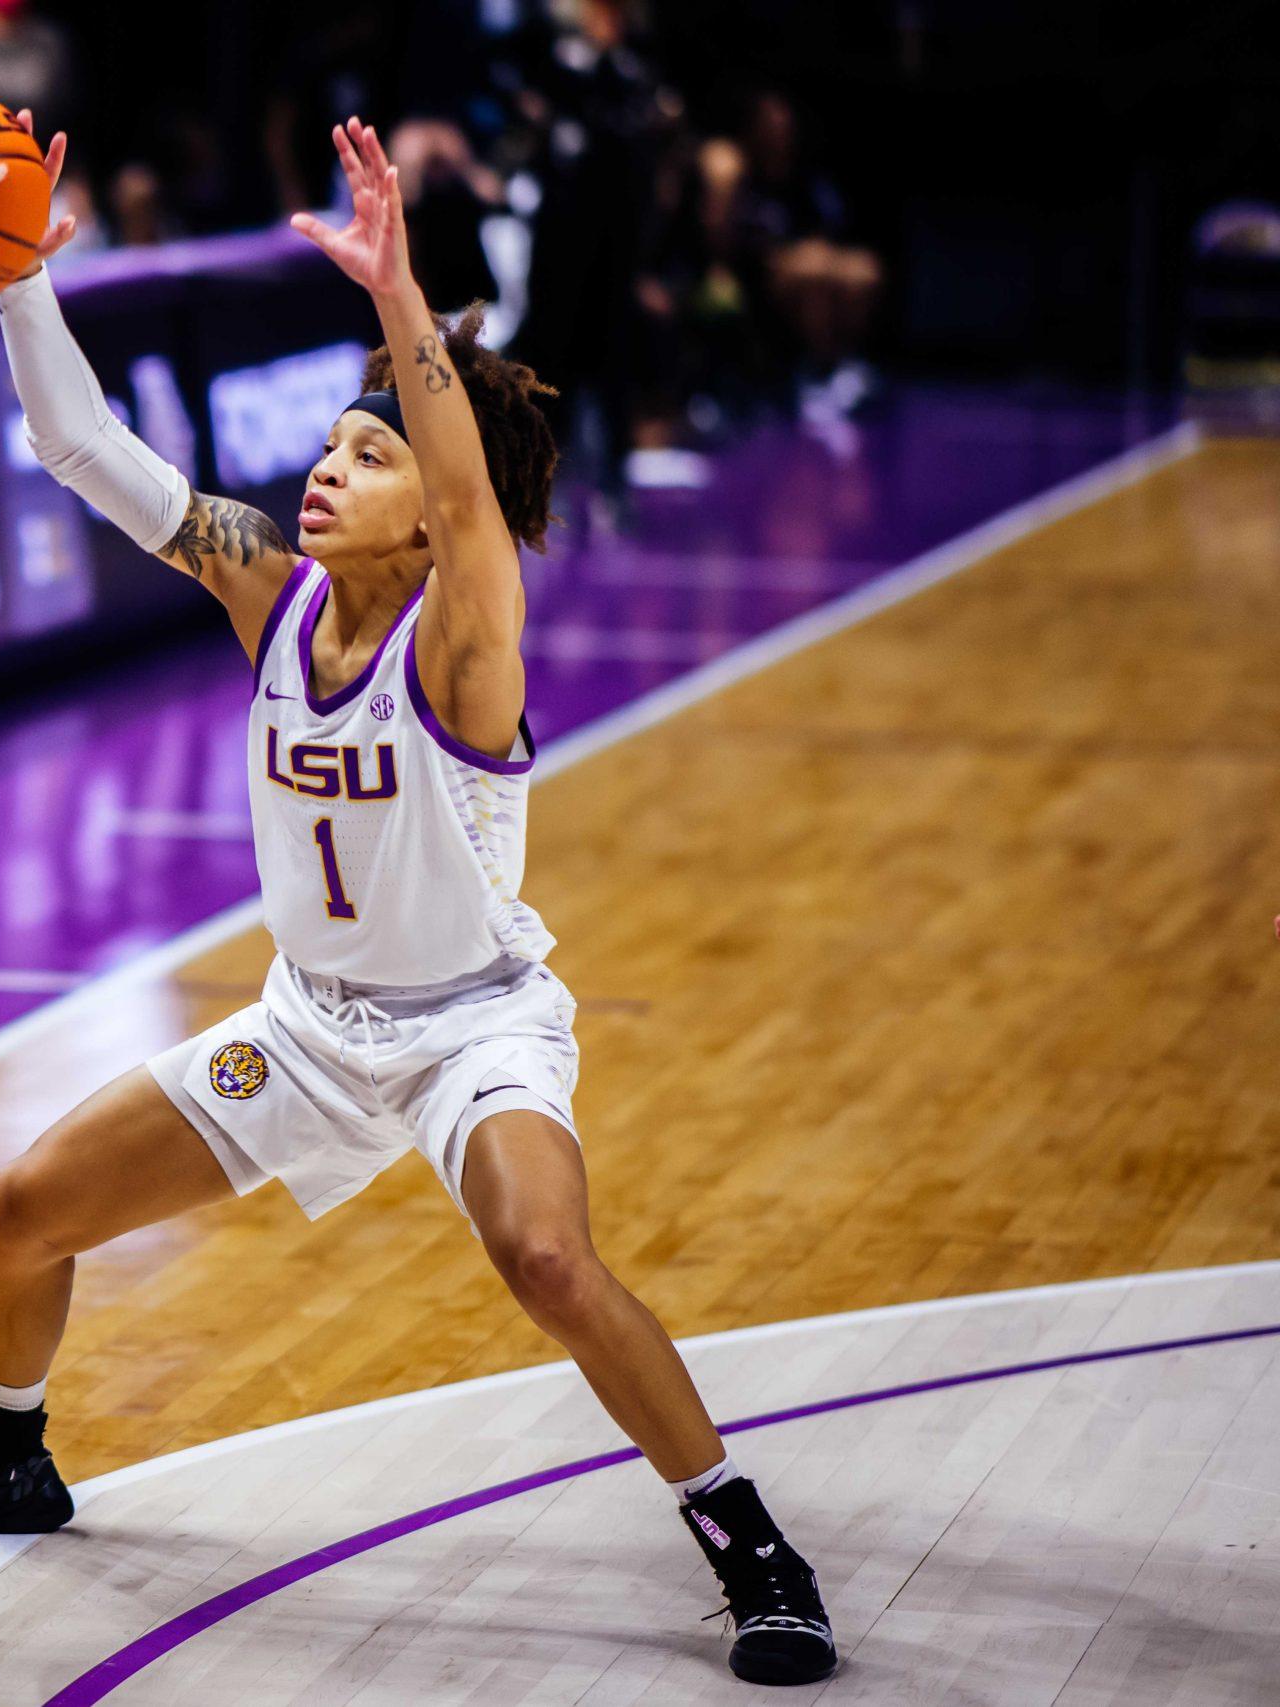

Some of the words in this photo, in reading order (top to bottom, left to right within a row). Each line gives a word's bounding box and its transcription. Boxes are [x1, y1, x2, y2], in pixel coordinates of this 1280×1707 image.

[371, 695, 394, 720] SEC
[267, 723, 398, 803] LSU
[314, 815, 357, 922] 1
